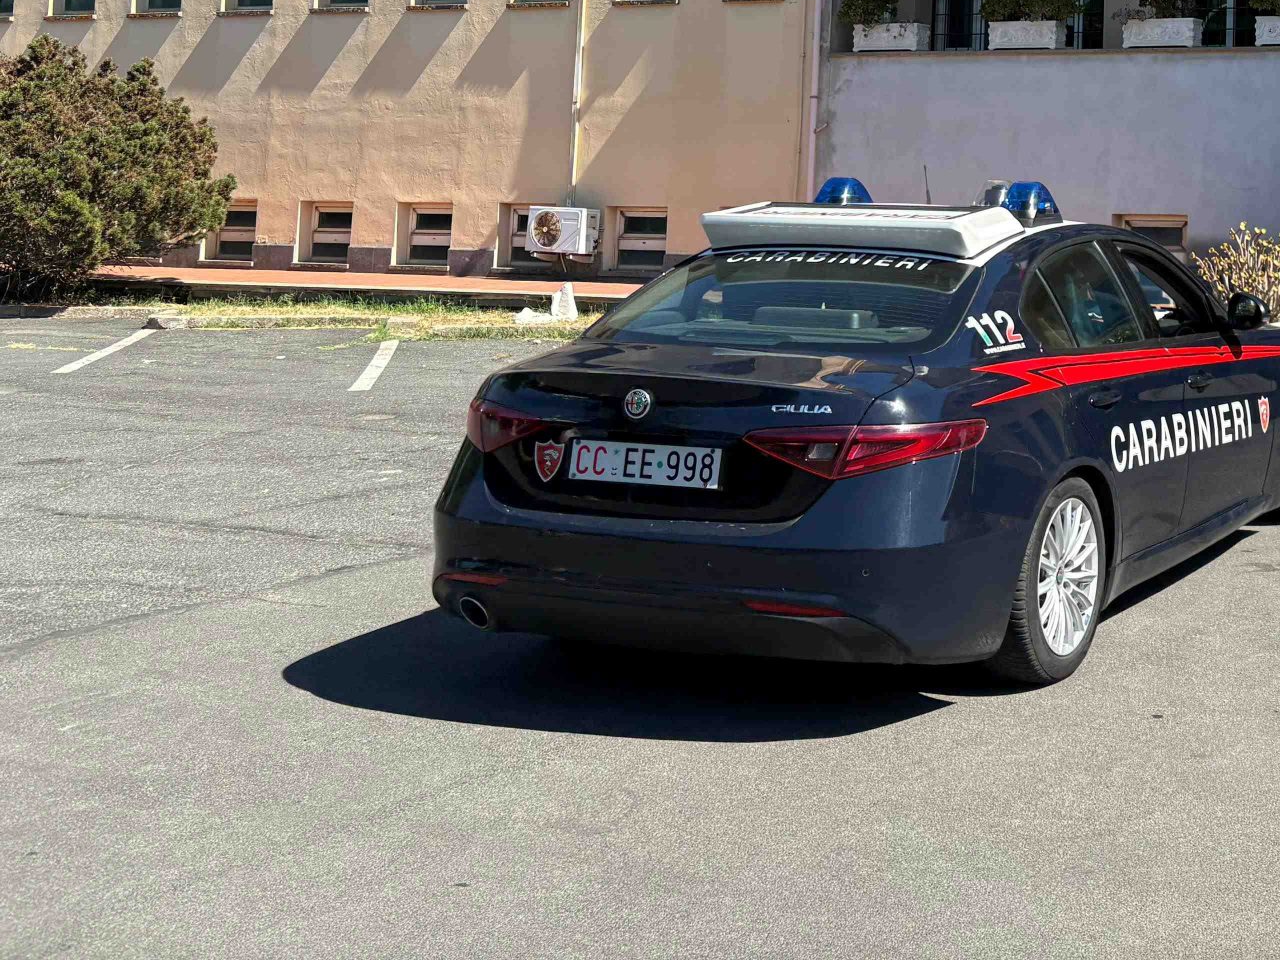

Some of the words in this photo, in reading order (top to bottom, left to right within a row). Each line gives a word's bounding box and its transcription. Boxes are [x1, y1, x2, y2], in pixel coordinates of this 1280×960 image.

[726, 251, 932, 271] CARABINIERI
[965, 310, 1023, 346] 112
[771, 404, 833, 414] GIULIA
[1110, 399, 1252, 473] CARABINIERI
[576, 445, 608, 476] CC
